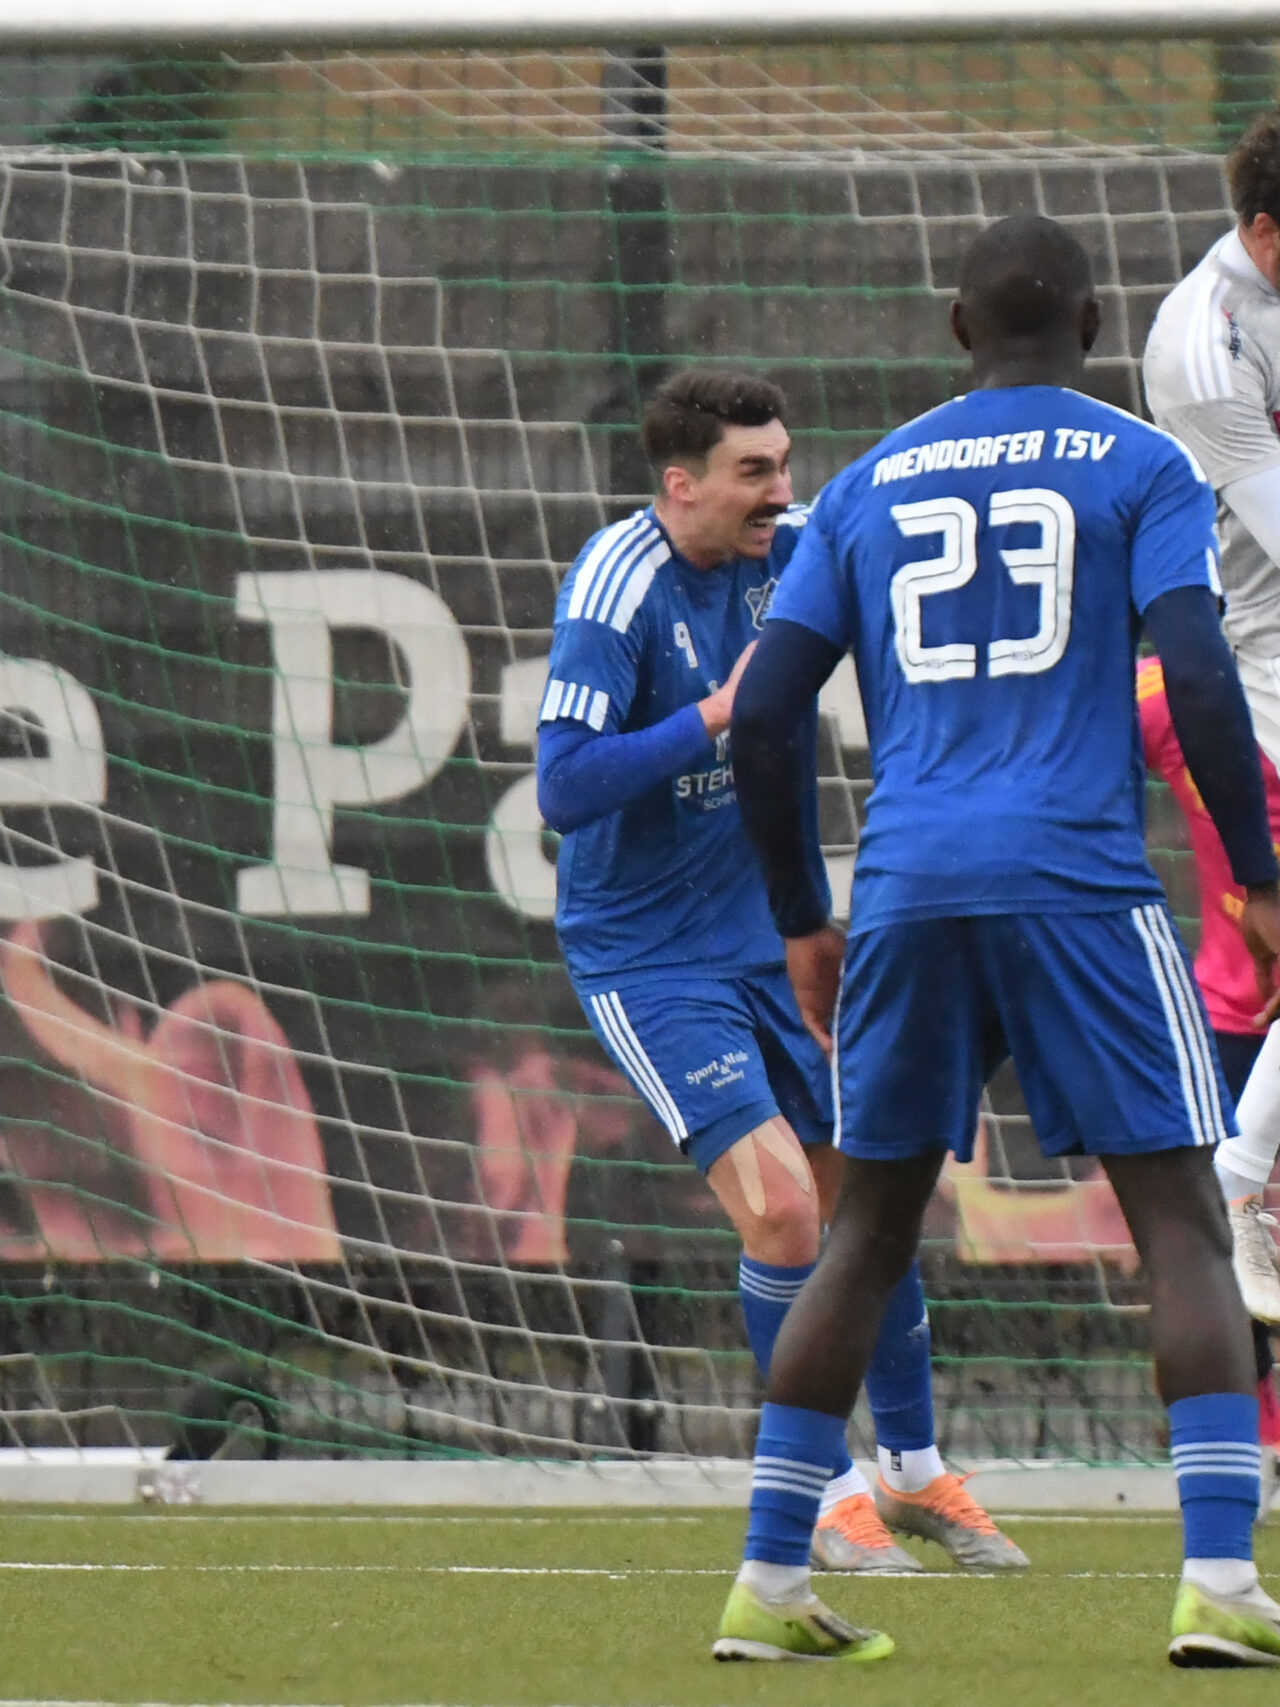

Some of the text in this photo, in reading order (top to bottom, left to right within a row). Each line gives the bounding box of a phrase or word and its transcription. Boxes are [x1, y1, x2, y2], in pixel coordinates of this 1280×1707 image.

[872, 428, 1116, 487] NIENDORFER TSV
[890, 487, 1076, 684] 23
[673, 621, 699, 669] 9
[0, 656, 106, 921] e
[685, 1059, 719, 1085] Sport
